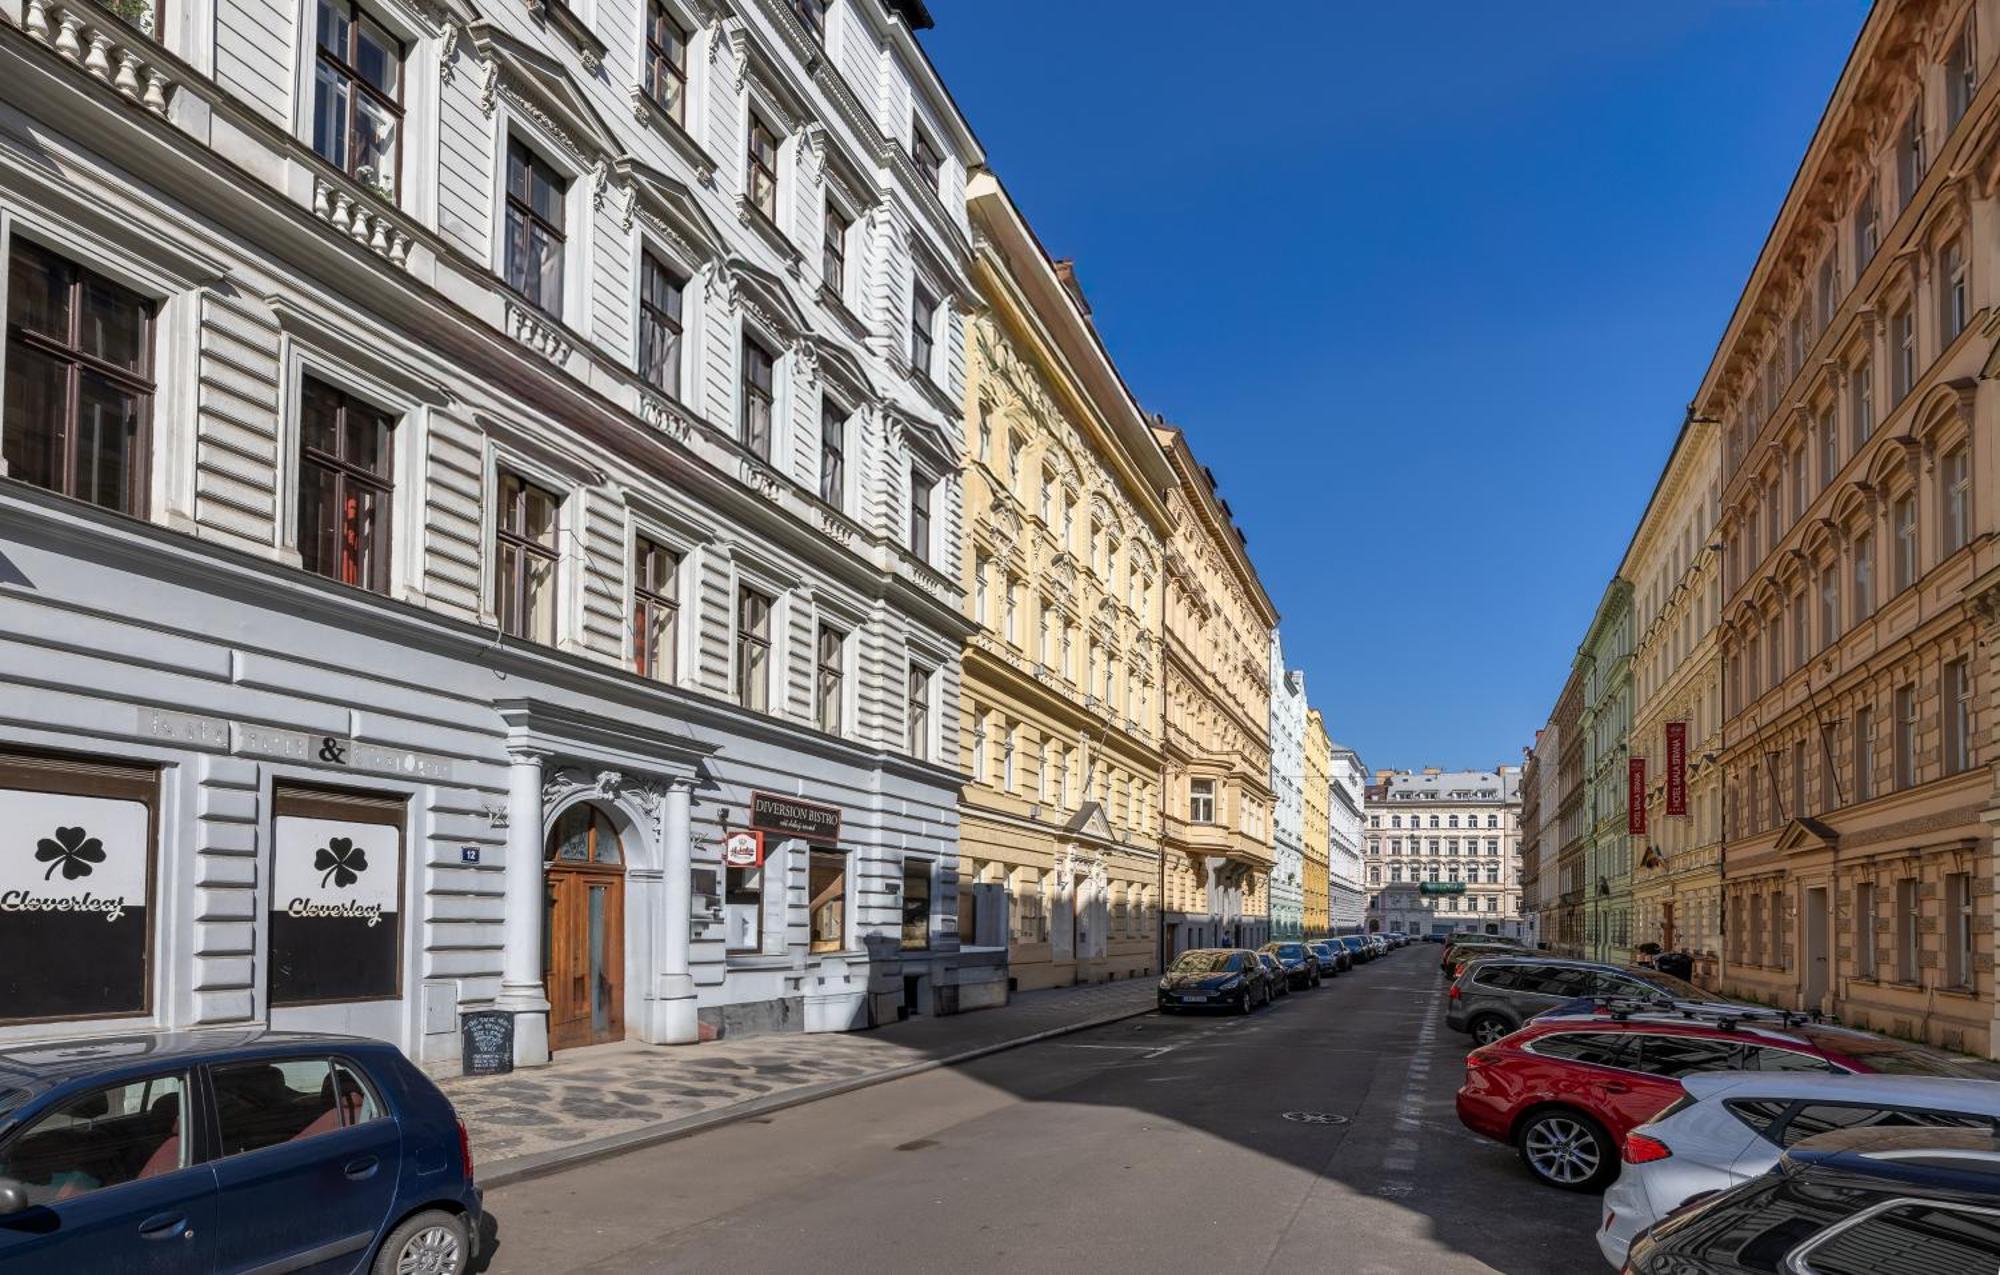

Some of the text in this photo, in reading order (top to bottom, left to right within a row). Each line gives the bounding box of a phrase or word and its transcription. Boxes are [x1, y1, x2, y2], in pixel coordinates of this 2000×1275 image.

[319, 737, 346, 765] &
[756, 800, 838, 826] DIVERSION BISTRO
[468, 850, 476, 860] 12
[0, 890, 125, 922] Cloverleaf
[288, 897, 382, 927] Cloverleaf
